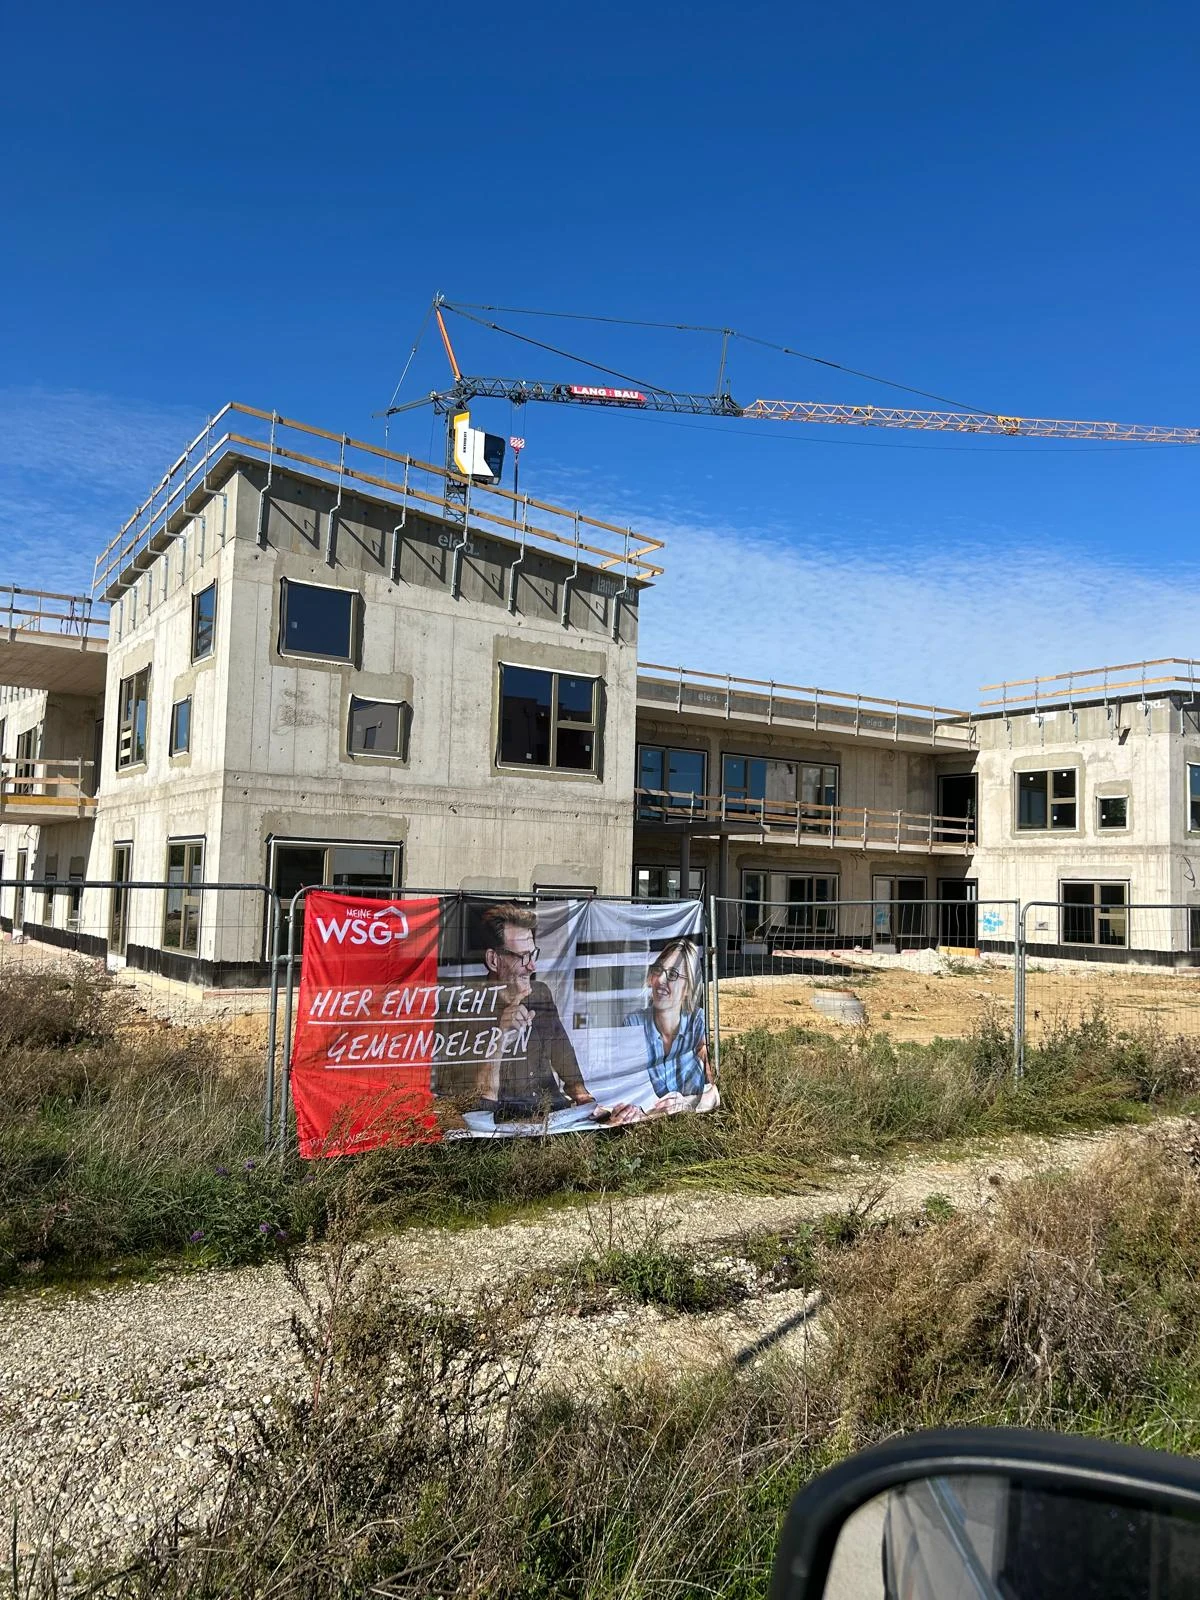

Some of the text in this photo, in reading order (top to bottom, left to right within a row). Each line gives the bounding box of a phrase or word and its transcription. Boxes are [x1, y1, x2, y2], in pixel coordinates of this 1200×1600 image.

[573, 386, 607, 396] LANG
[613, 389, 639, 399] BAU
[346, 908, 372, 919] MEINE
[315, 917, 393, 945] WSG
[309, 985, 507, 1018] HIER ENTSTEHT
[327, 1026, 533, 1063] GEMEINDELEBEN
